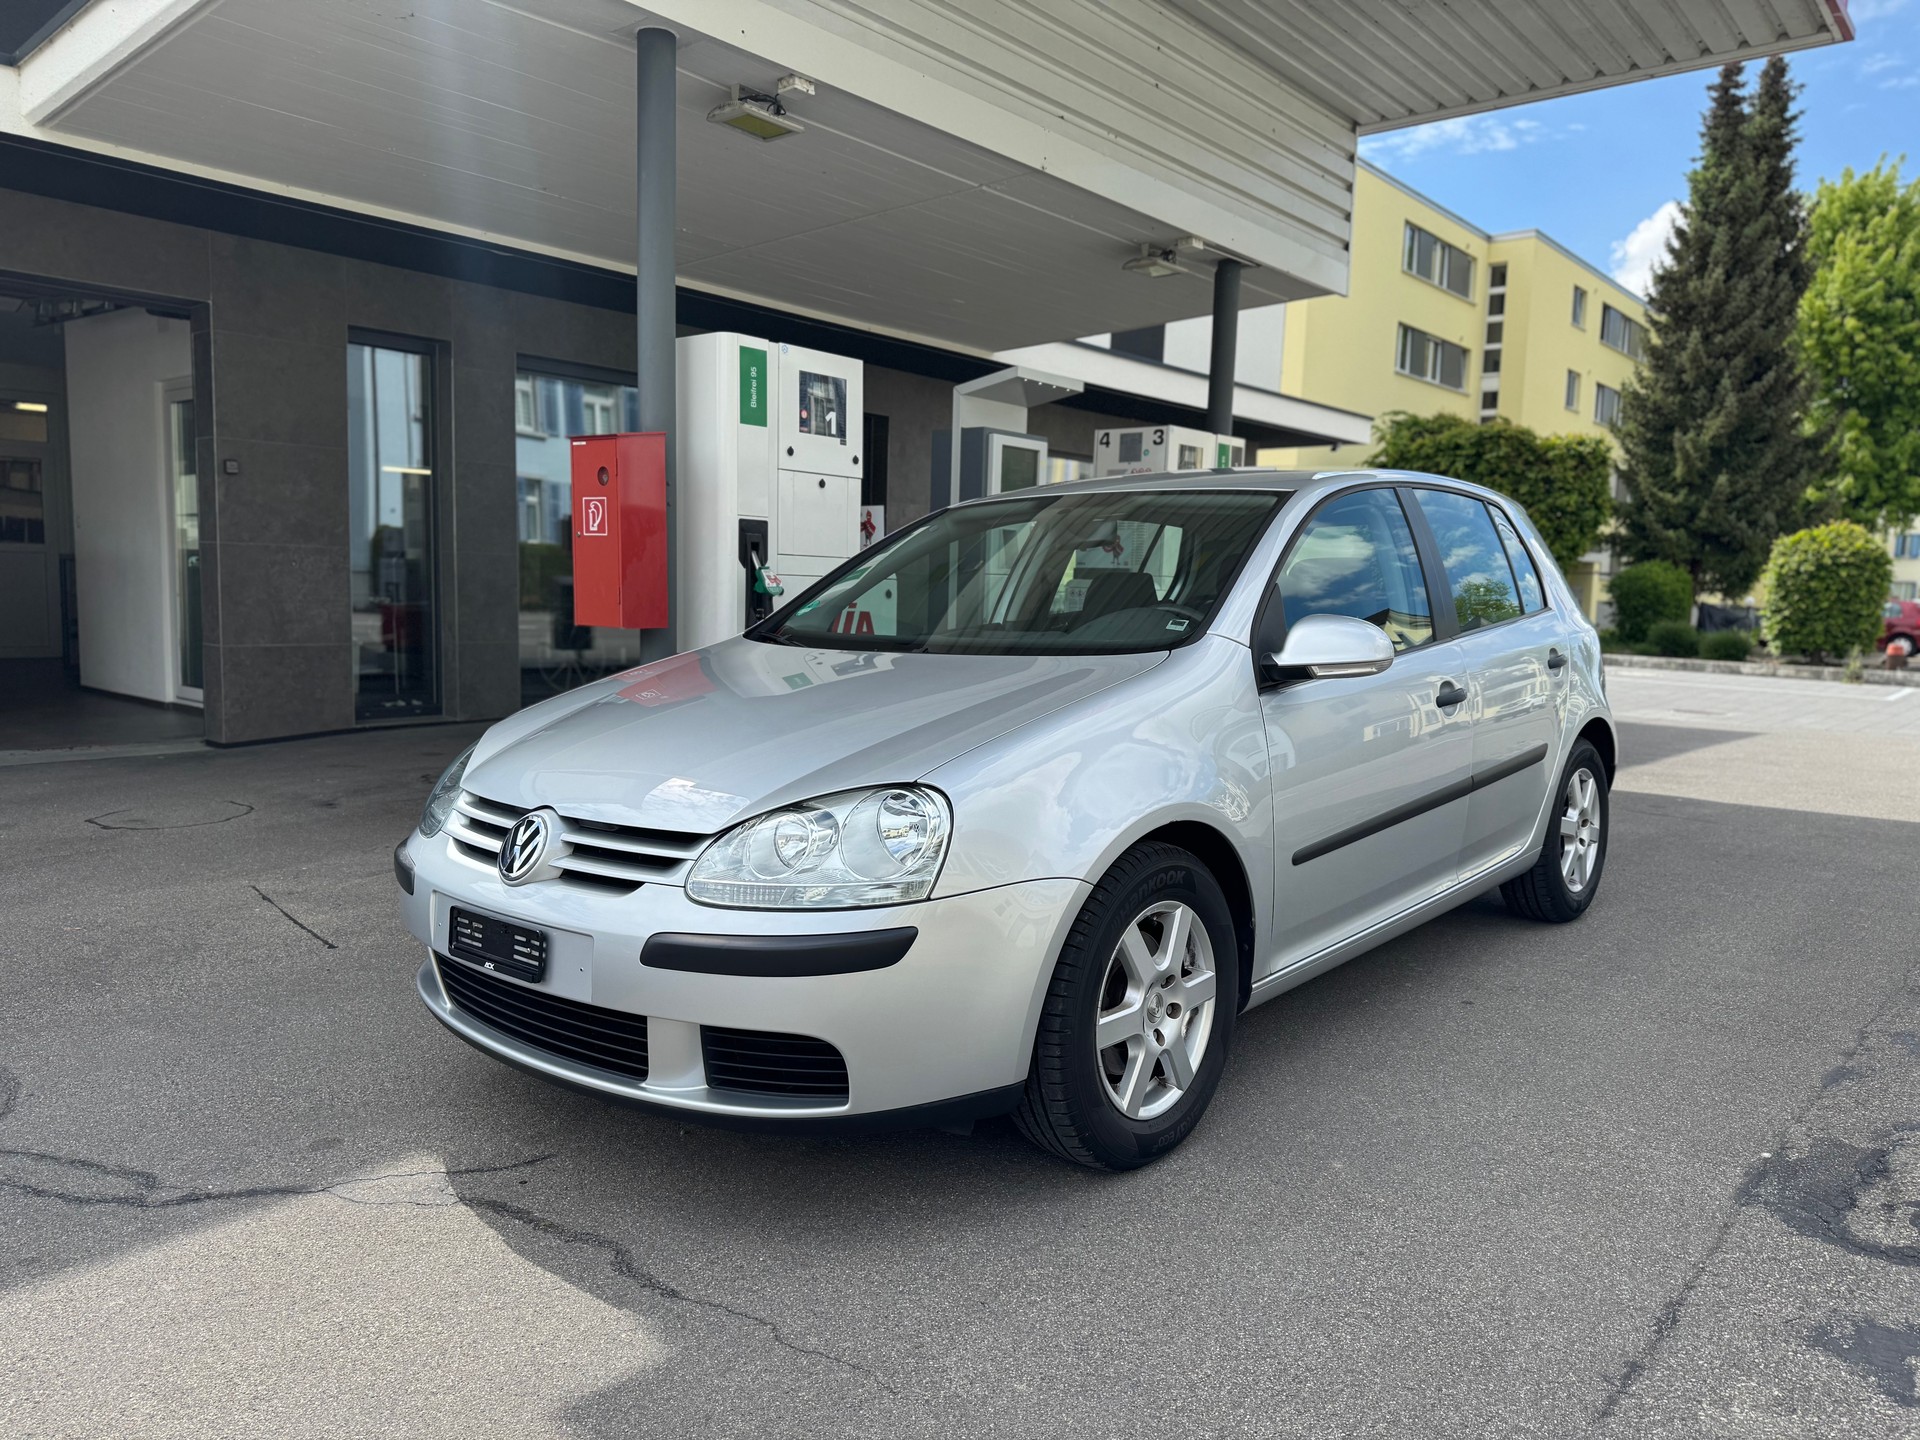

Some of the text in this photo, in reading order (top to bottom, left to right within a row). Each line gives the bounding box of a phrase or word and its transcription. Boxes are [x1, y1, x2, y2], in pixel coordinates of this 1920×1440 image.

[750, 366, 757, 378] 95
[825, 411, 837, 435] 1
[1099, 432, 1110, 448] 4
[1152, 429, 1165, 446] 3
